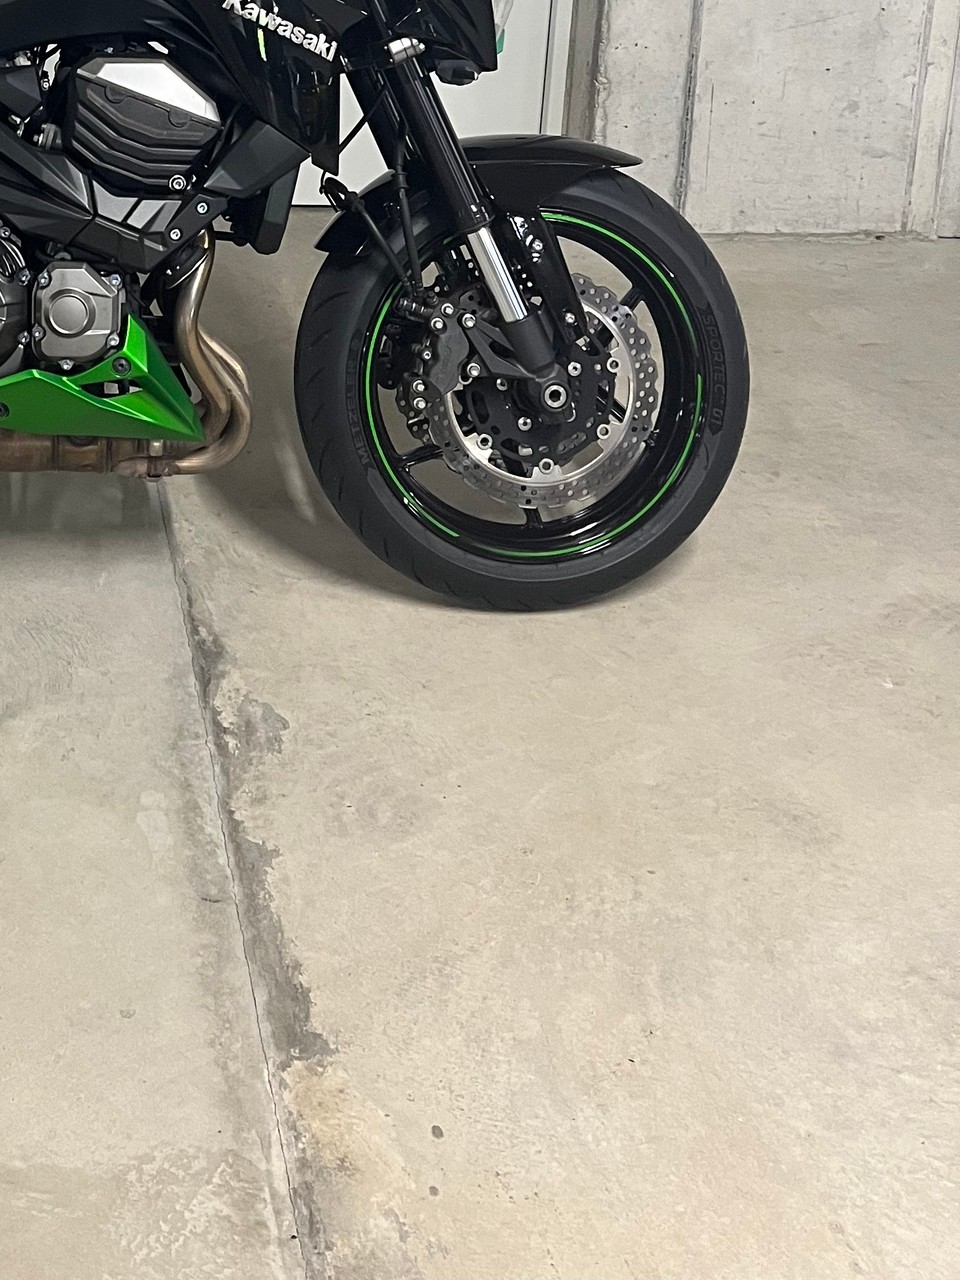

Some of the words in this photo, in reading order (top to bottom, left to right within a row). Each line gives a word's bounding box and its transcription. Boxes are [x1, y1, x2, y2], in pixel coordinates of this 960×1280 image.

[703, 315, 726, 396] SPORTEC
[346, 358, 370, 465] METZELER
[711, 407, 724, 426] 01
